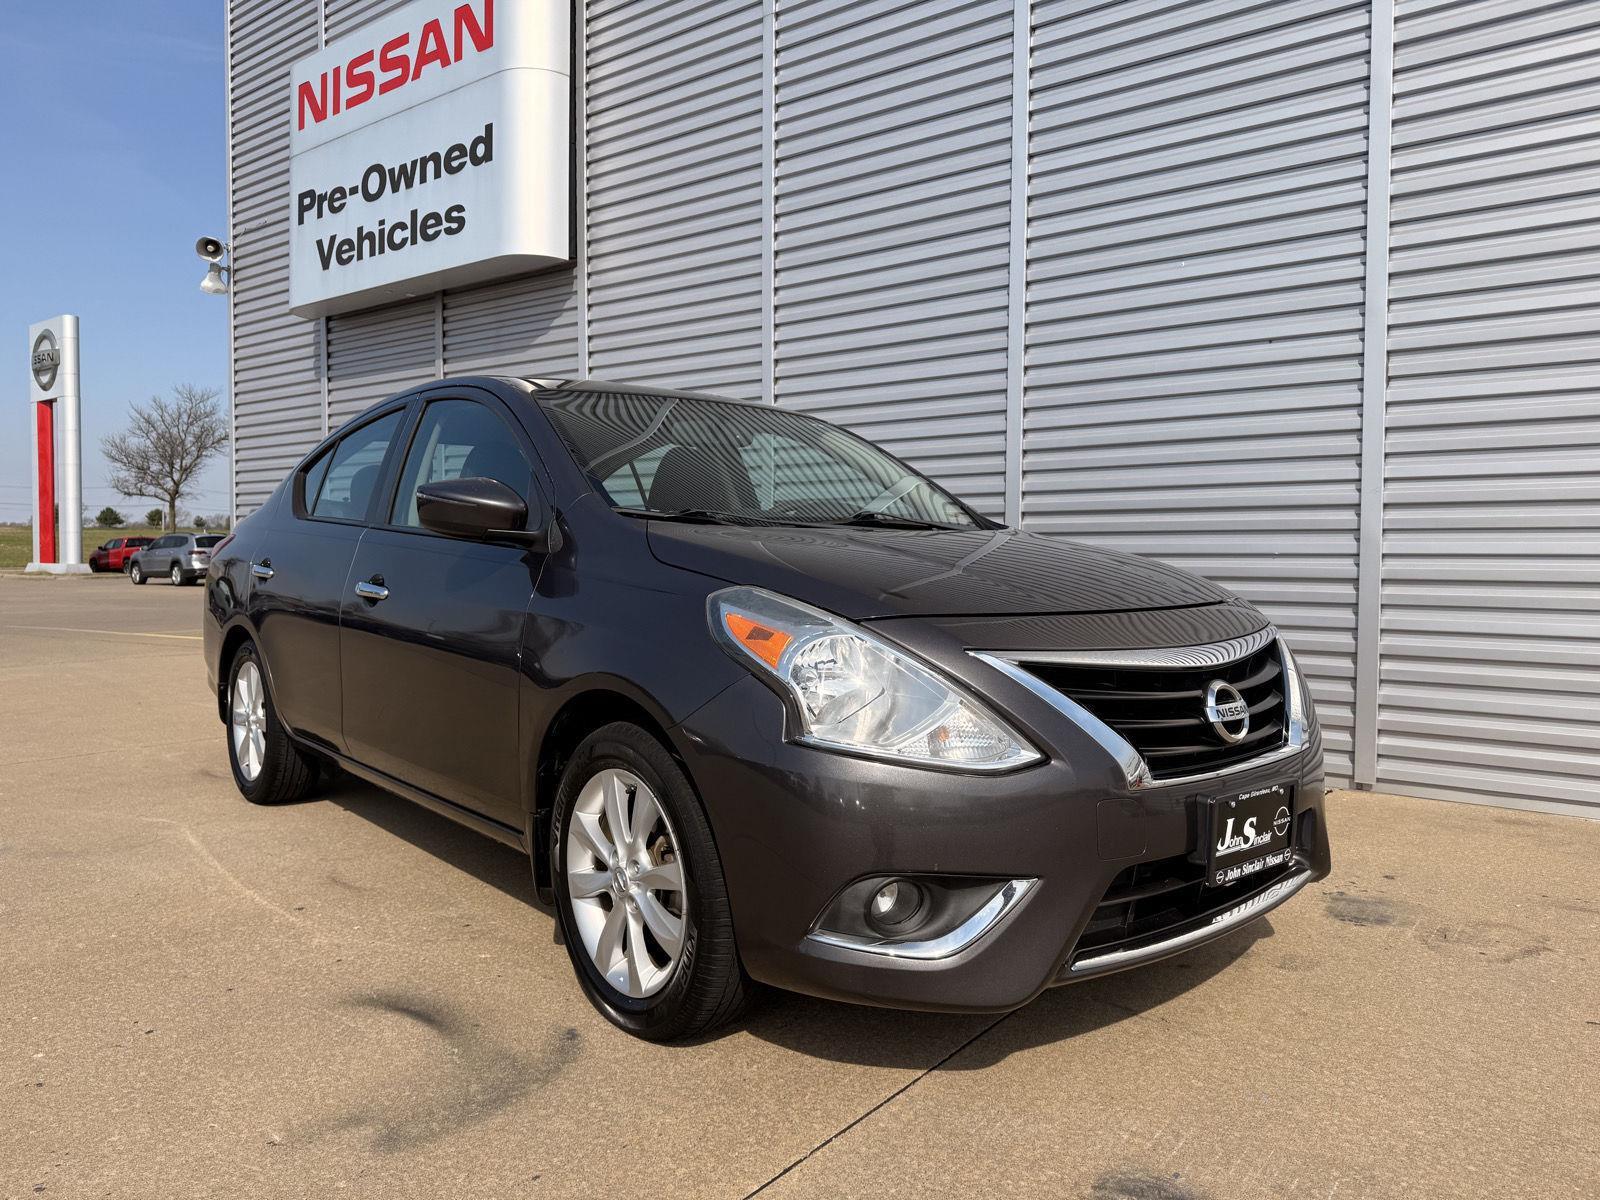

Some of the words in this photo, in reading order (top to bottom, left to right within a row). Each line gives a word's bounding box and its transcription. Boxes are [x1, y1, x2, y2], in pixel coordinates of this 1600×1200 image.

[298, 0, 494, 131] NISSAN
[298, 122, 493, 225] Pre-Owned
[316, 203, 466, 270] Vehicles
[1216, 817, 1244, 851] John
[1243, 816, 1273, 848] Sinclair
[1225, 867, 1241, 881] John
[1242, 858, 1264, 875] Sinclair
[1265, 854, 1284, 868] Nissan
